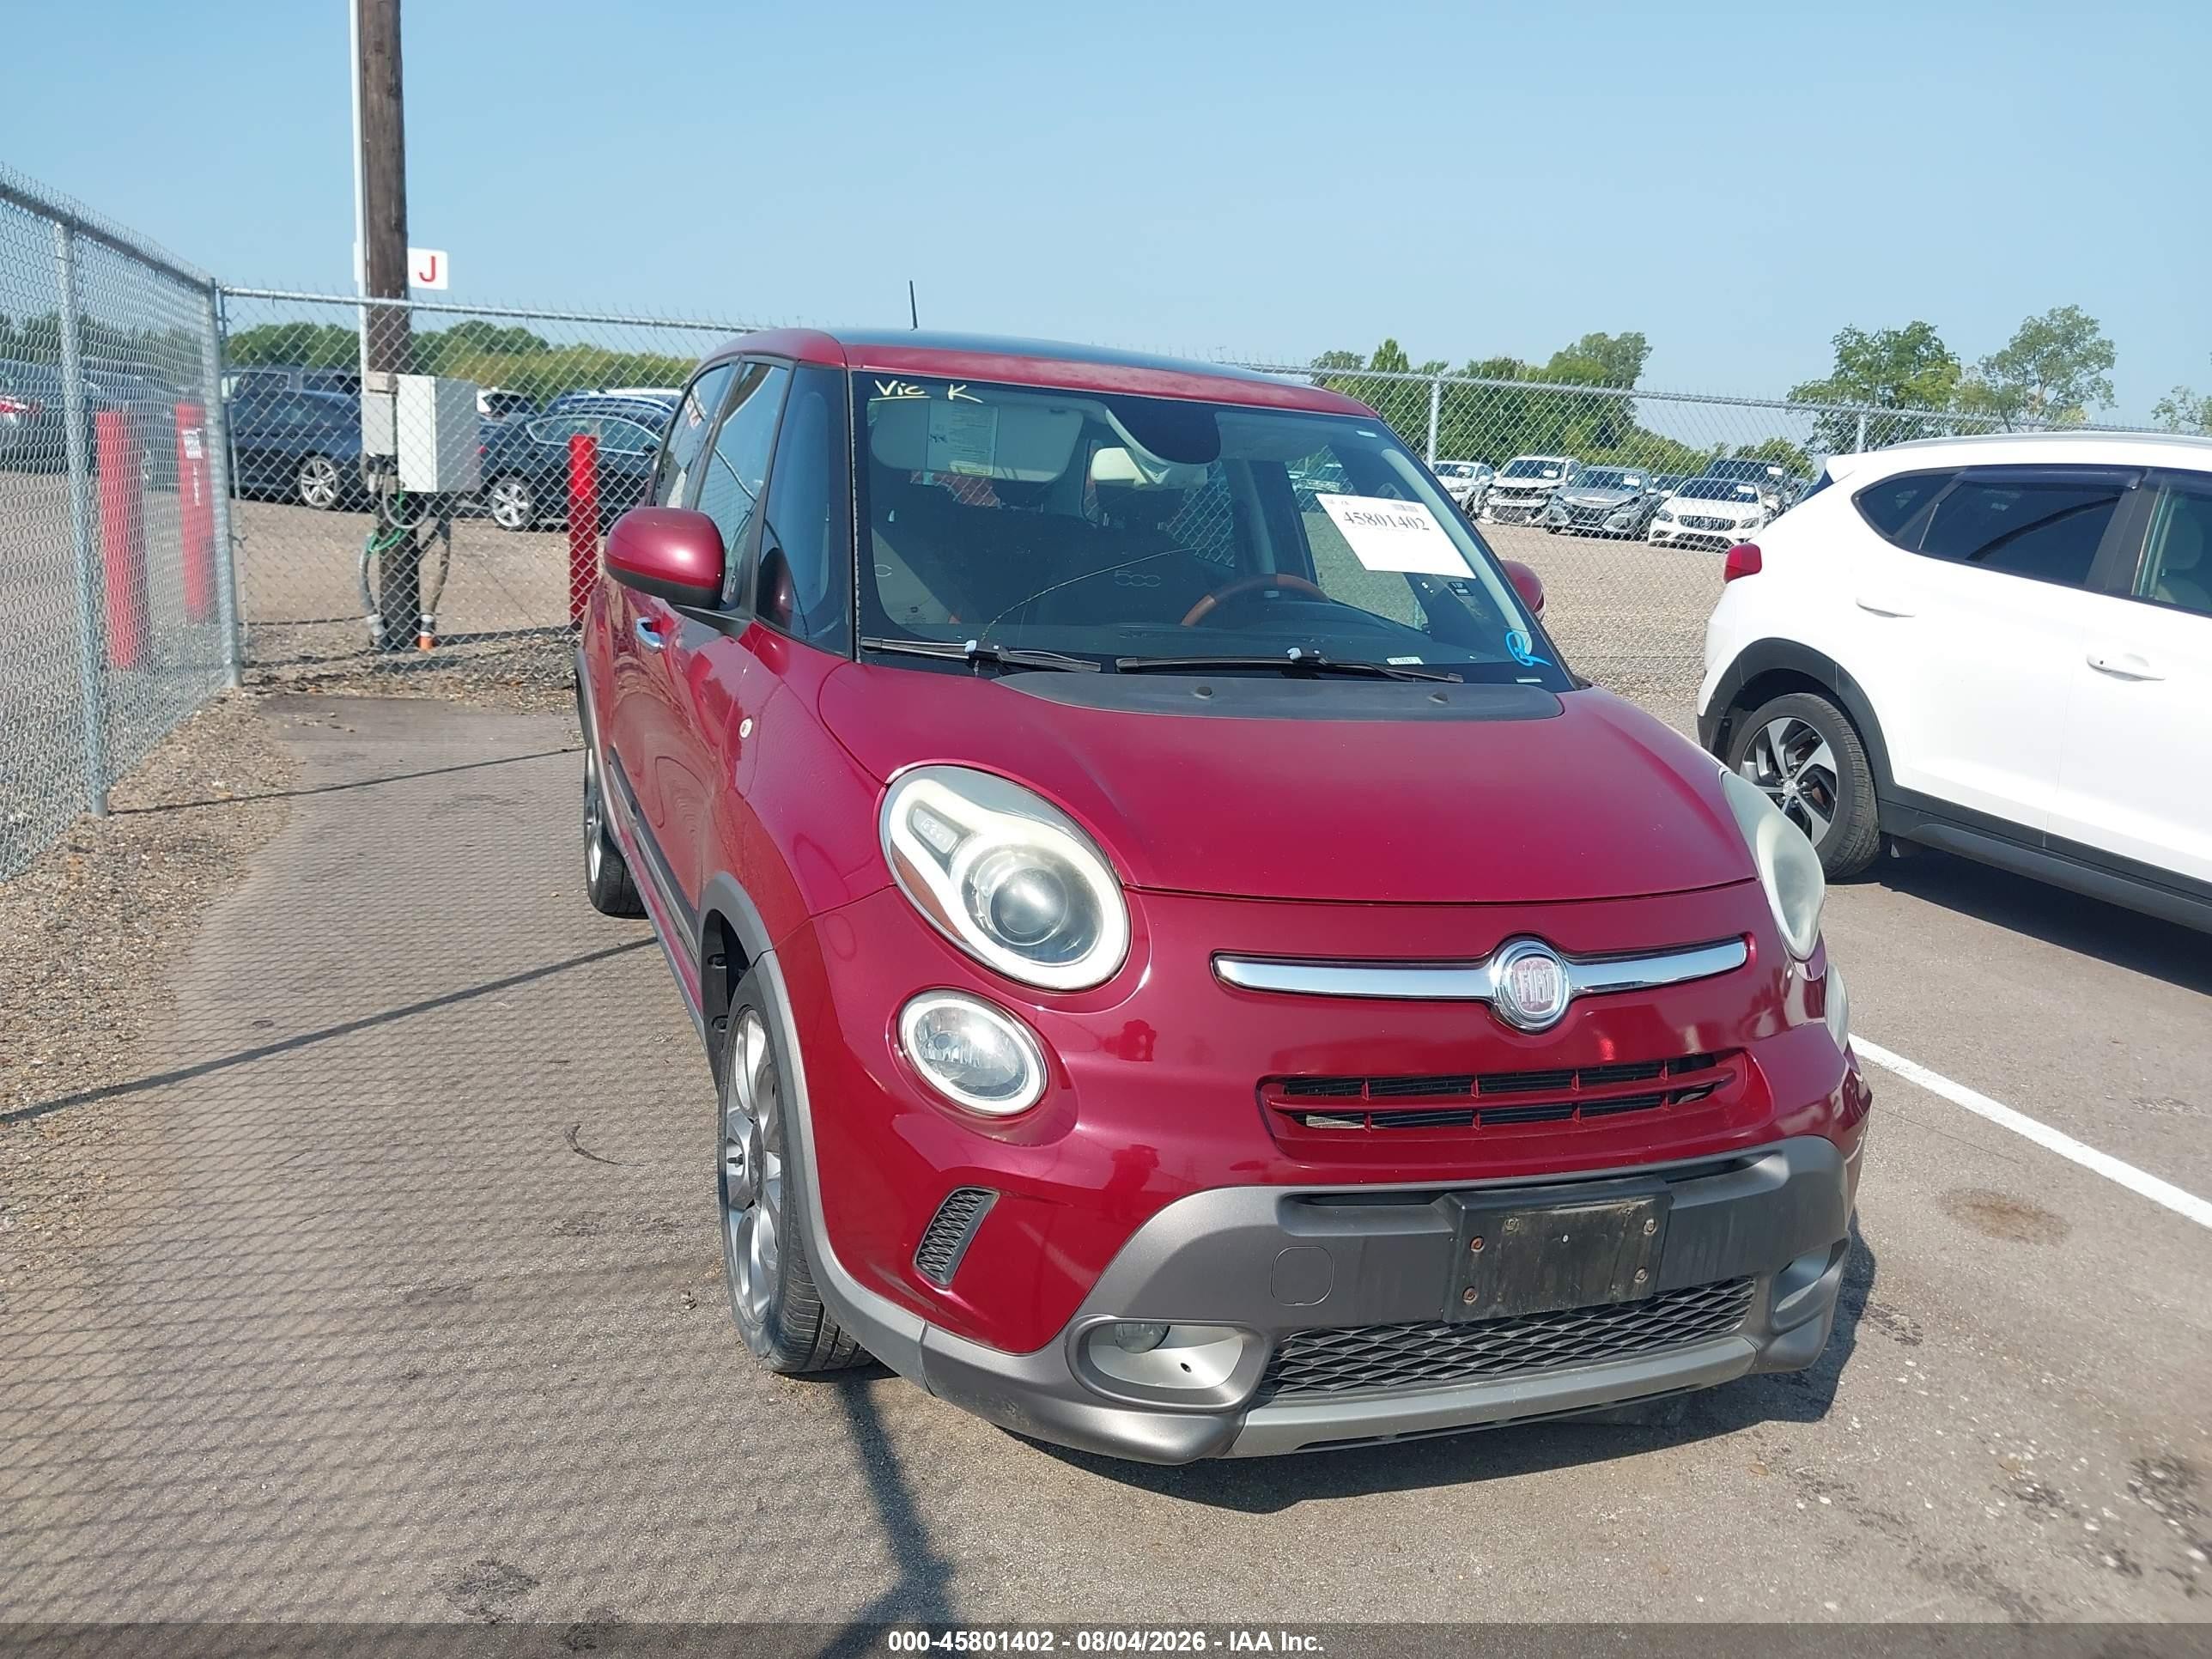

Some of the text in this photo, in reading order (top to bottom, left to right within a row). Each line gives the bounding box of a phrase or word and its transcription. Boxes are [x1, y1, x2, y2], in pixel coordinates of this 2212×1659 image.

[419, 255, 436, 283] J
[947, 383, 984, 404] K
[1344, 511, 1430, 531] 45801402
[1518, 968, 1554, 1003] FIAT
